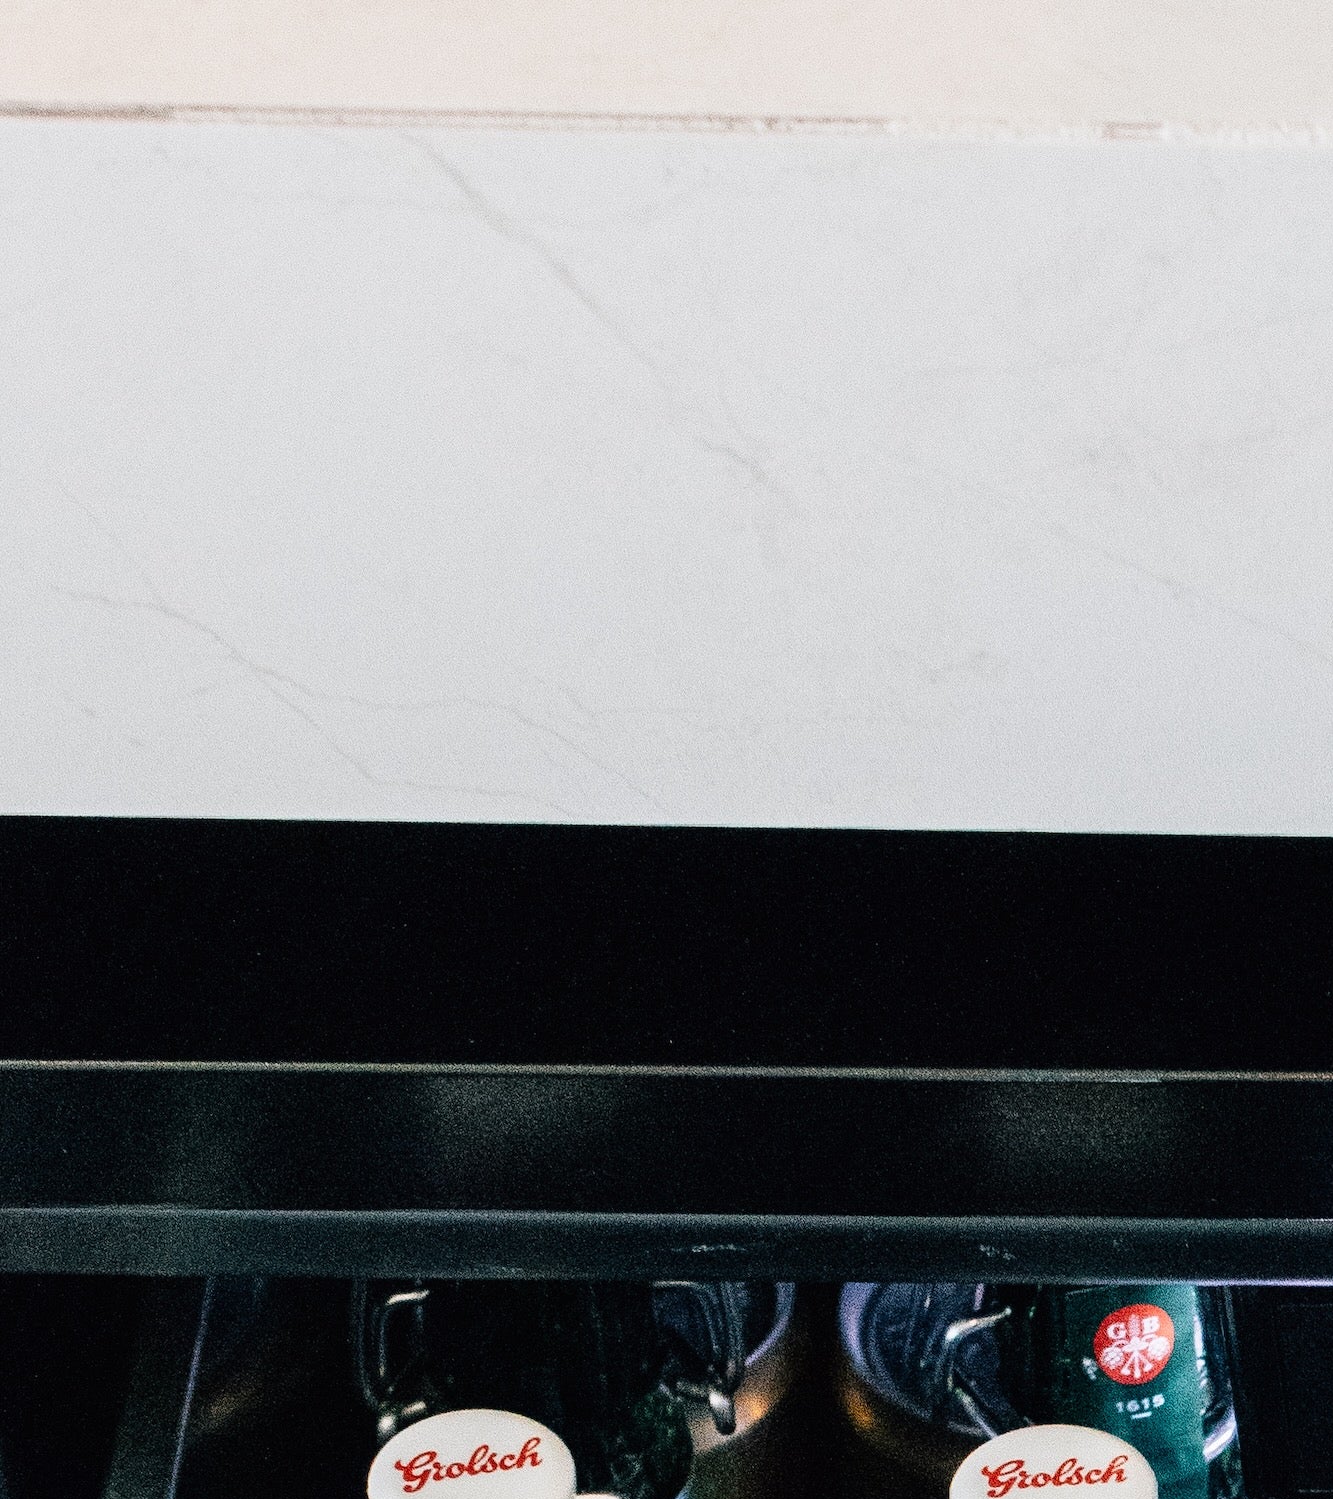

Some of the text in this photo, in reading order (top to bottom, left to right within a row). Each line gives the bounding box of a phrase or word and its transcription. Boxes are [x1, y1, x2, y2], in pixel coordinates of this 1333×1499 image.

[1142, 1314, 1161, 1335] B
[393, 1436, 543, 1494] Grolsch
[981, 1455, 1128, 1498] Grolsch
